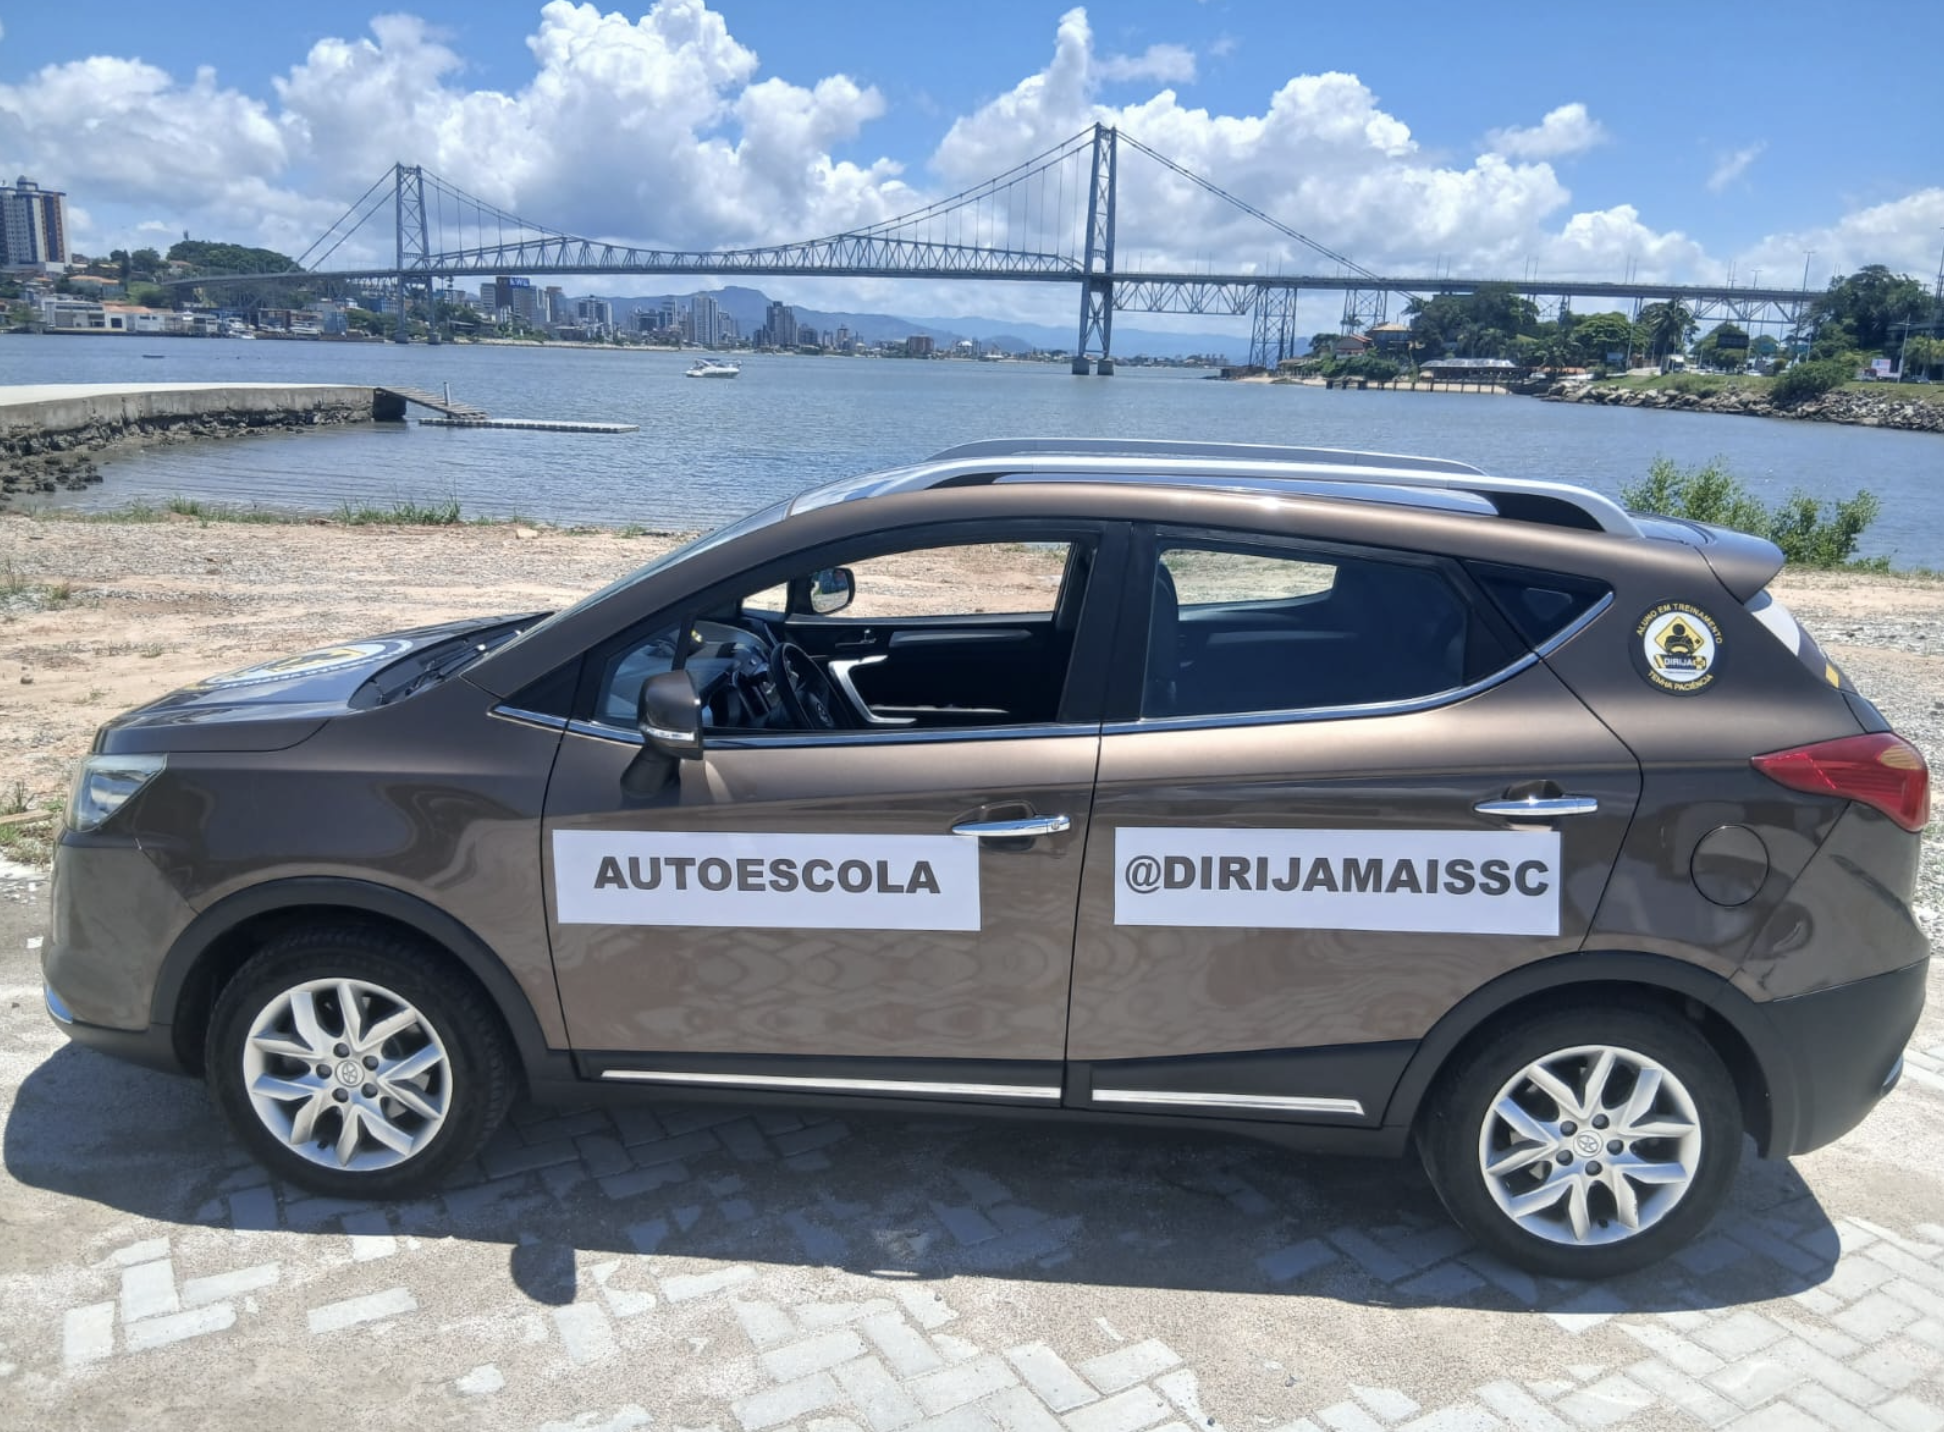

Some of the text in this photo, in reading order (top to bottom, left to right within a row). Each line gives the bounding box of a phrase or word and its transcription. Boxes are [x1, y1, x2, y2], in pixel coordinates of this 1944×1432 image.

[1636, 603, 1723, 644] ALUNO EM TREINAMENTO
[1647, 671, 1673, 690] TENHA
[1664, 658, 1693, 666] DIRIJA
[594, 856, 941, 894] AUTOESCOLA
[1125, 855, 1549, 896] @DIRIJAMAISSC
